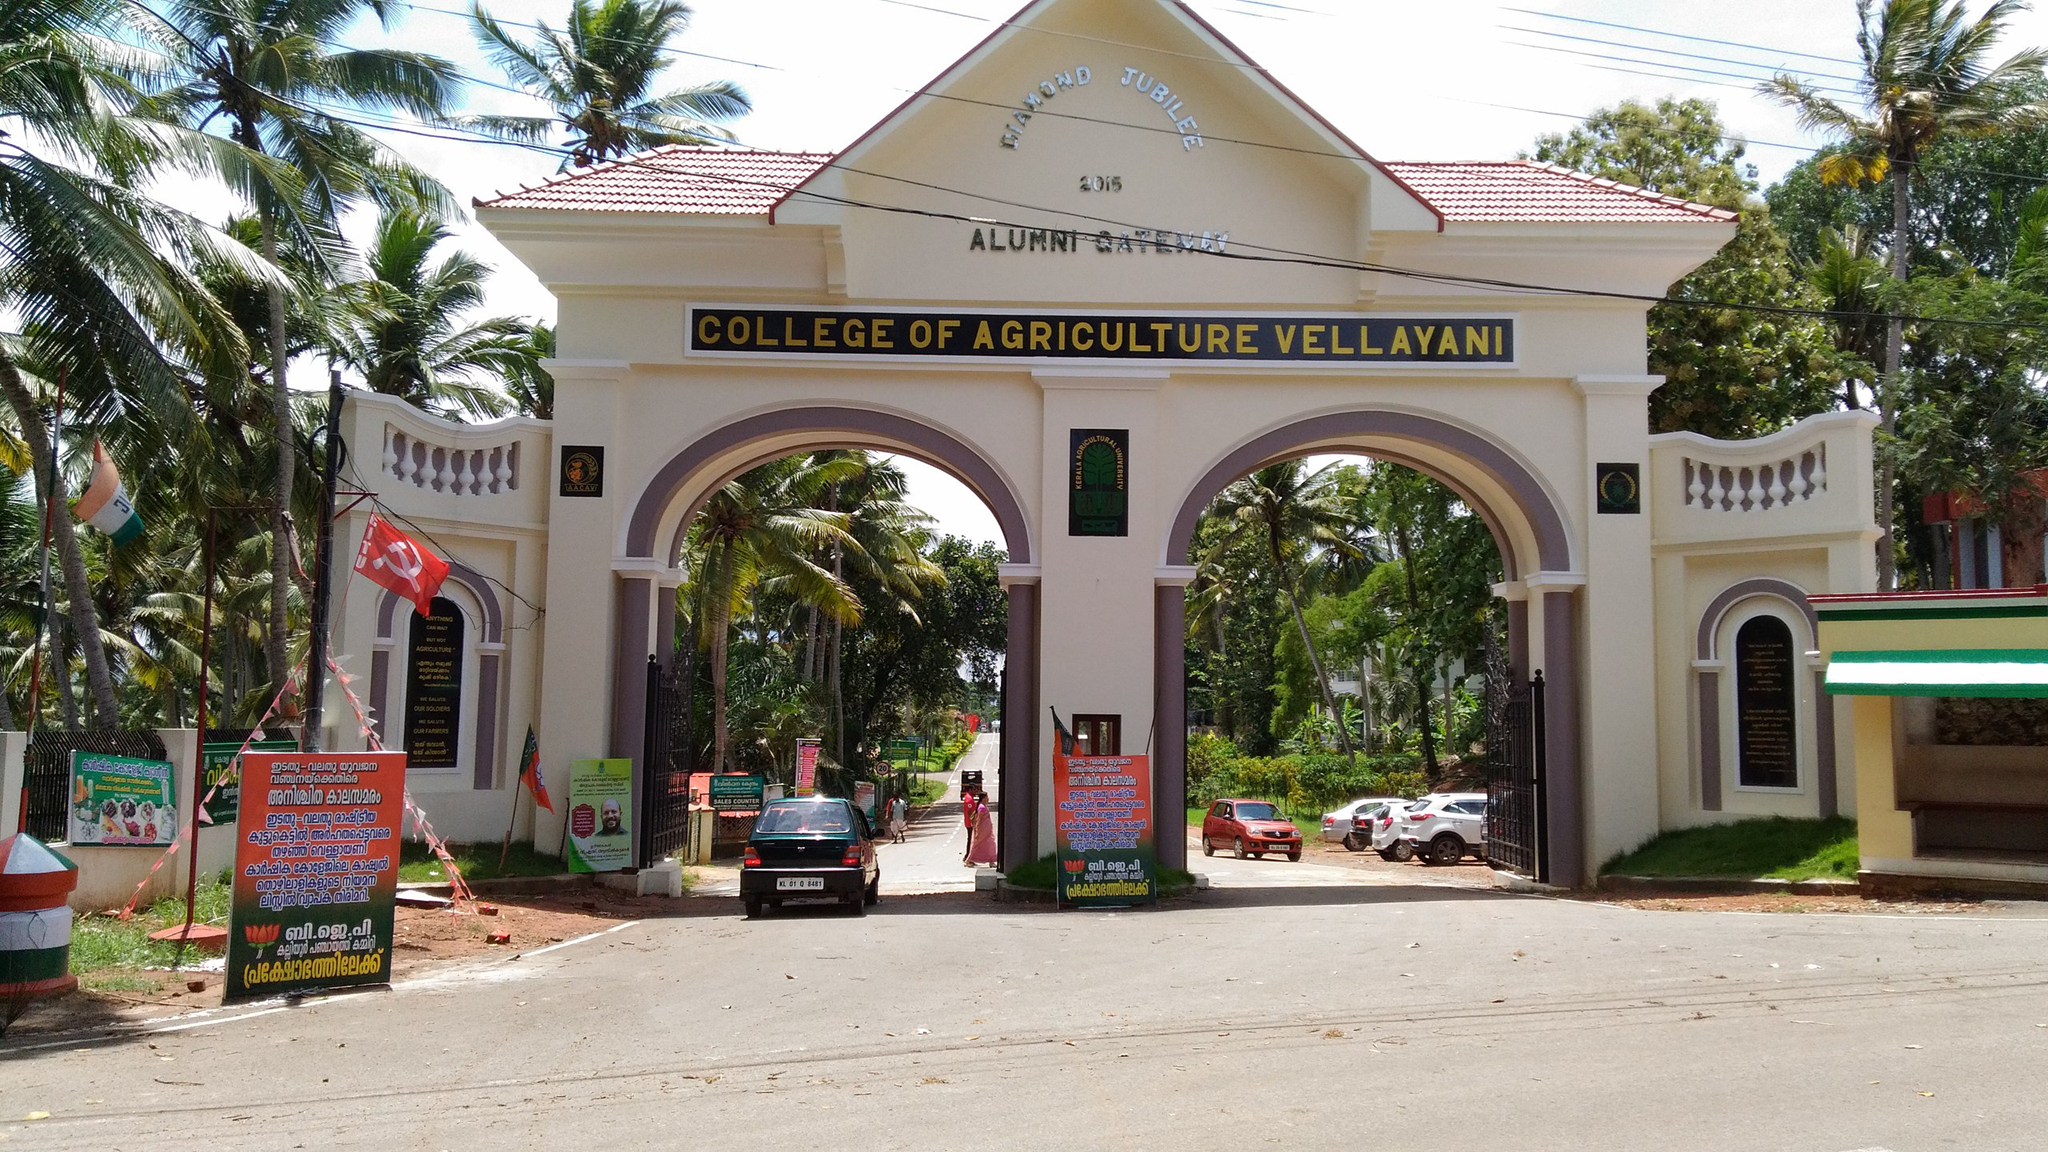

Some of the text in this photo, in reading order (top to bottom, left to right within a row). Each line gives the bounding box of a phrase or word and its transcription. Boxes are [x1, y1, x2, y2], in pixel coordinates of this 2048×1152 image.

[1000, 65, 1204, 151] DIAMOND JUBILEE
[1079, 175, 1122, 192] 2015
[970, 228, 1230, 254] ALUMNI GATEWAY
[697, 315, 1503, 356] COLLEGE OF AGRICULTURE VELLAYANI
[1075, 435, 1117, 460] AGRICULTURAL
[1115, 447, 1124, 490] UNIVERSITY
[339, 762, 378, 773] യുവജന
[326, 789, 382, 805] കാലസമരം
[310, 840, 368, 859] വെള്ളായണി
[245, 859, 292, 876] കാർഷിക
[342, 873, 377, 887] നിയമന
[297, 892, 332, 908] വ്യാപക
